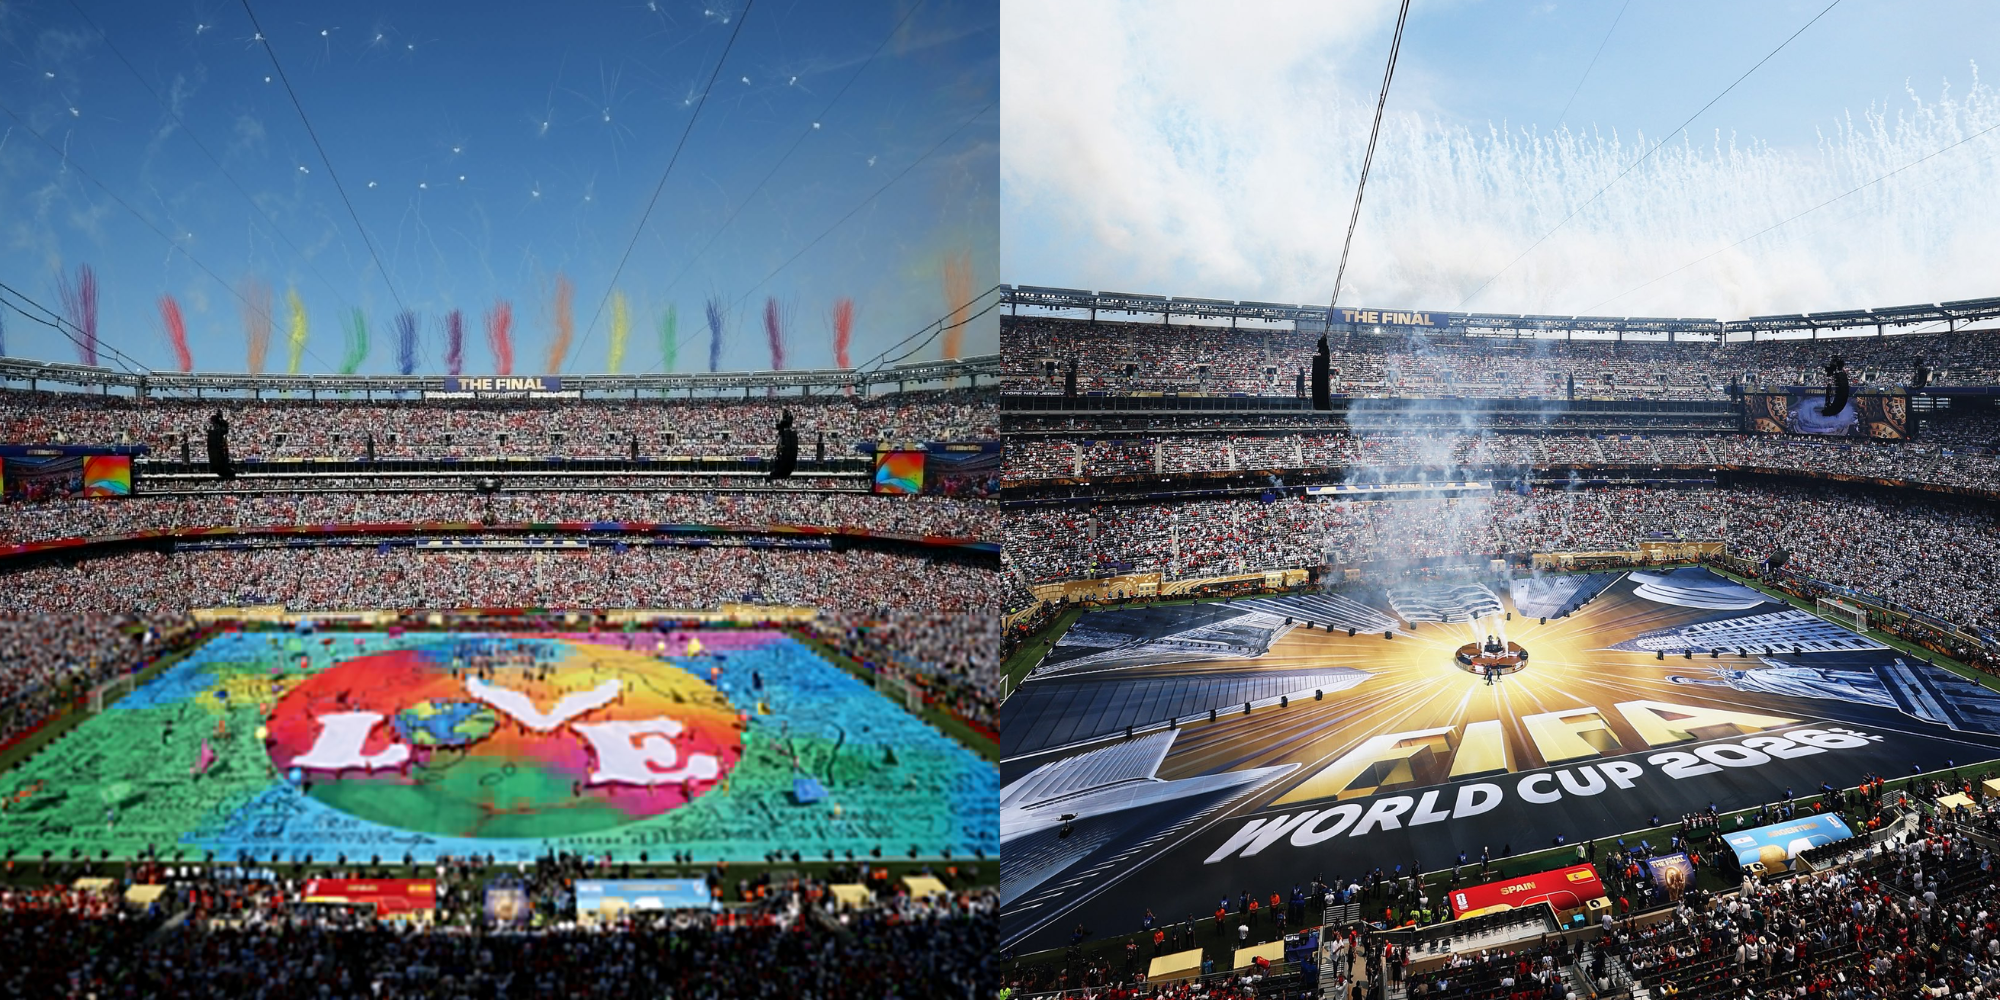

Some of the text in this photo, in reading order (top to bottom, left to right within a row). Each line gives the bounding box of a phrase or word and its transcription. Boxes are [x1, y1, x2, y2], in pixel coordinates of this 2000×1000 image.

[1342, 310, 1434, 325] THE FINAL
[458, 378, 546, 390] THE FINAL
[1267, 700, 1802, 807] FIFA
[1203, 782, 1503, 865] WORLD
[1517, 761, 1644, 804] CUP
[1648, 729, 1870, 780] 2026
[1767, 823, 1818, 837] ARGENTINA
[1651, 860, 1665, 868] THE
[1666, 857, 1686, 865] FINAL
[1500, 881, 1536, 895] SPAIN
